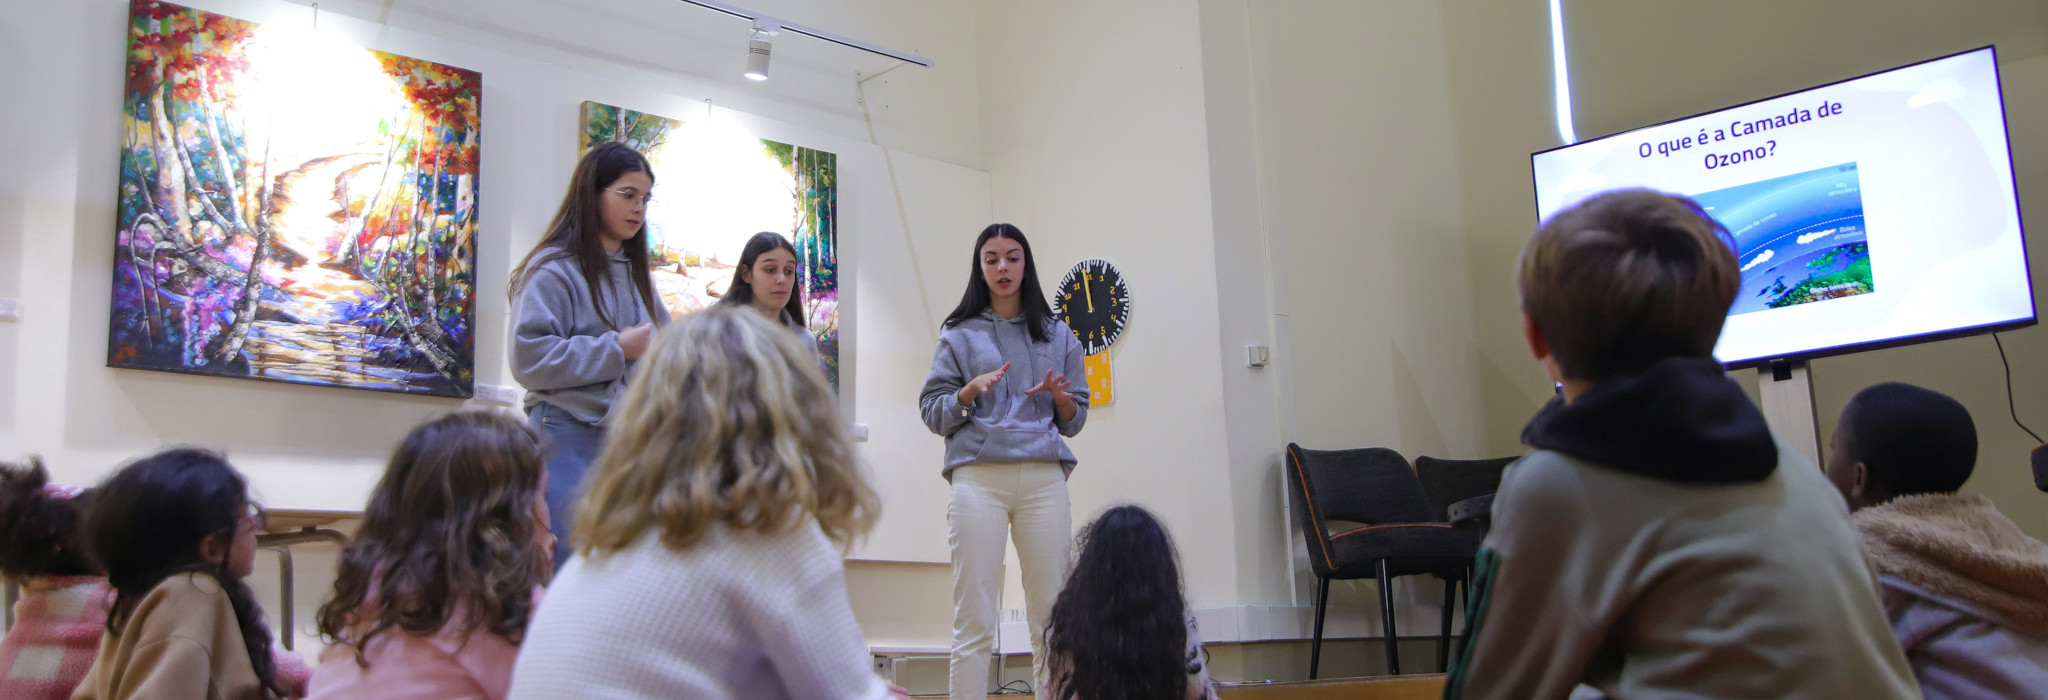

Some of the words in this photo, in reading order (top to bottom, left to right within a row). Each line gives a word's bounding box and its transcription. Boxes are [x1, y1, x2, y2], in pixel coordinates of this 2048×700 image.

[1639, 142, 1652, 158] O
[1657, 136, 1692, 157] que
[1697, 128, 1708, 145] é
[1714, 129, 1725, 142] a
[1730, 107, 1812, 138] Camada
[1818, 100, 1843, 118] de
[1704, 140, 1776, 169] Ozono?
[1099, 274, 1105, 282] 1
[1110, 286, 1116, 294] 2
[1111, 297, 1117, 306] 3
[1062, 304, 1068, 313] 9
[1065, 316, 1070, 325] 8
[1111, 314, 1117, 322] 4
[1089, 331, 1094, 339] 6
[1100, 326, 1106, 335] 5
